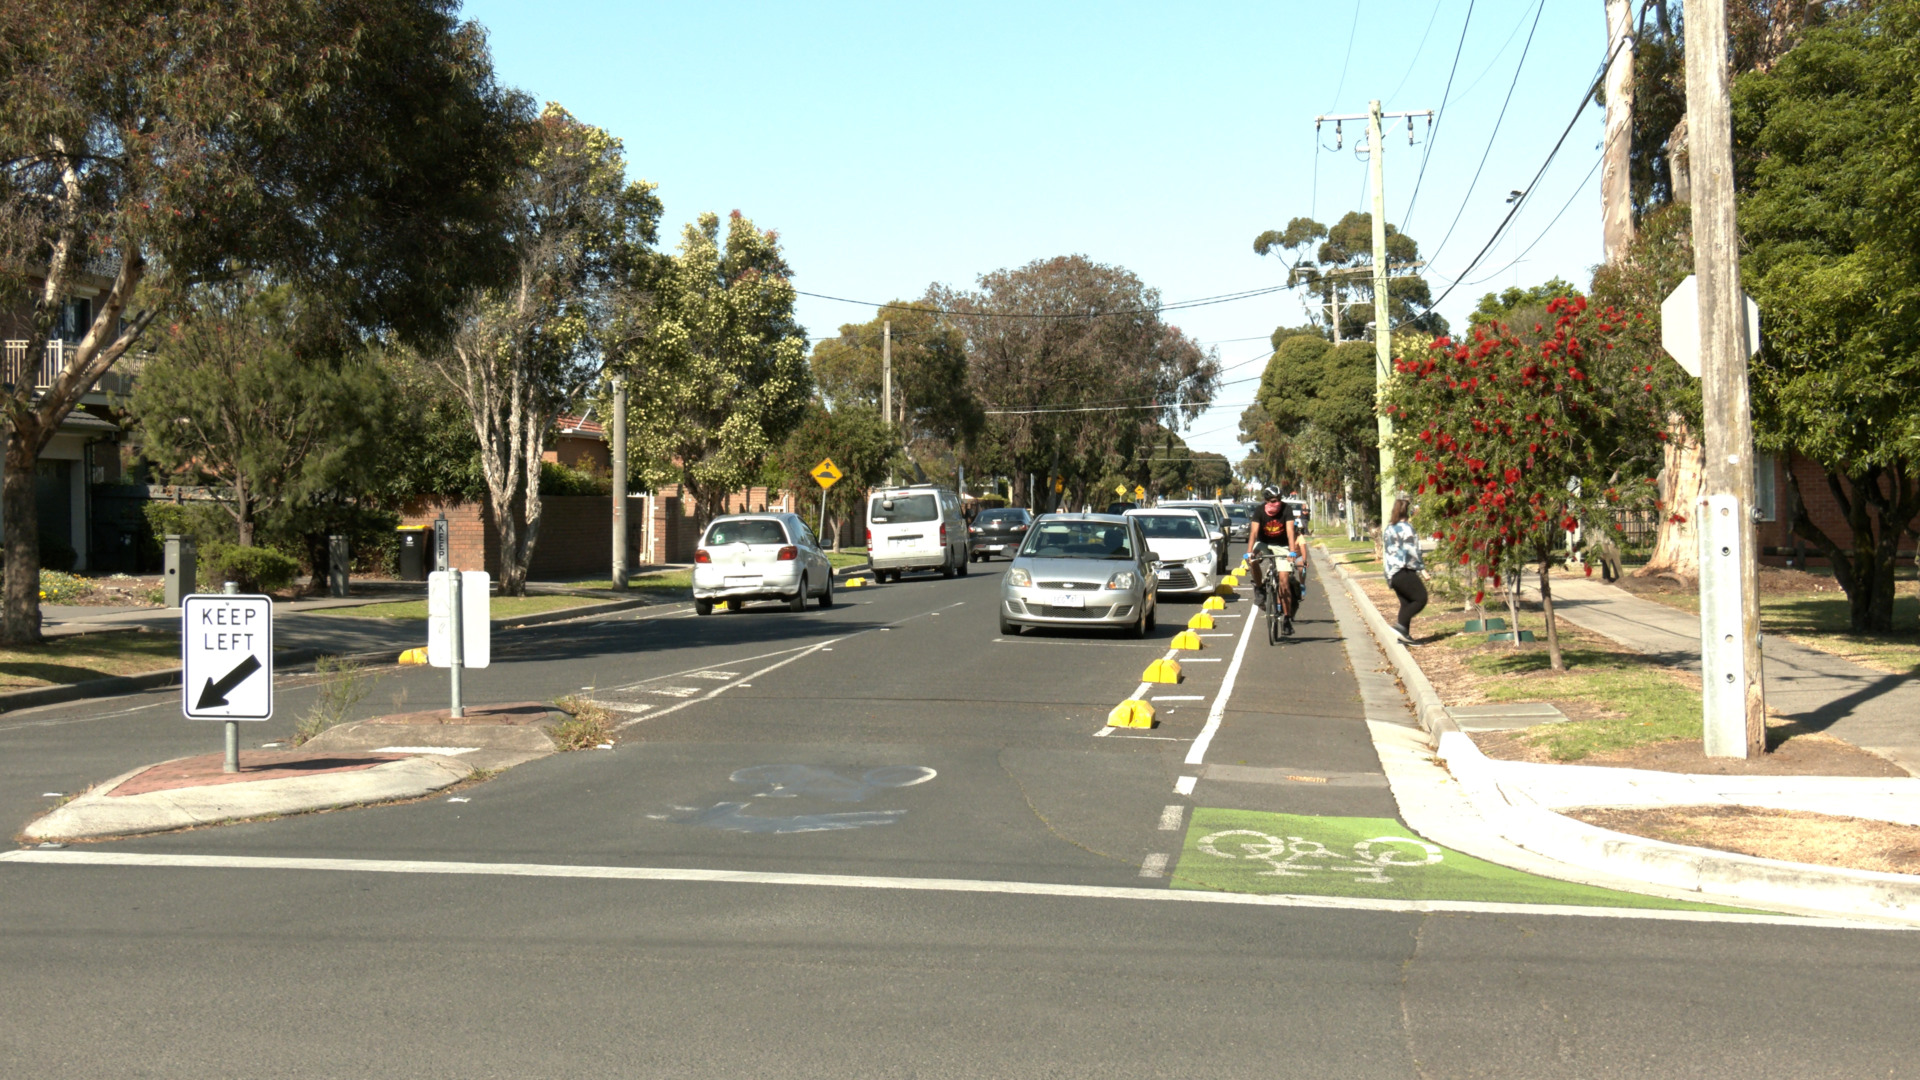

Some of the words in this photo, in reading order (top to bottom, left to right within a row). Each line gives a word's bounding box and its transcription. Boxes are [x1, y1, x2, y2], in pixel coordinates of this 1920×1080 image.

[716, 534, 723, 543] P
[202, 608, 256, 625] KEEP
[204, 633, 254, 650] LEFT
